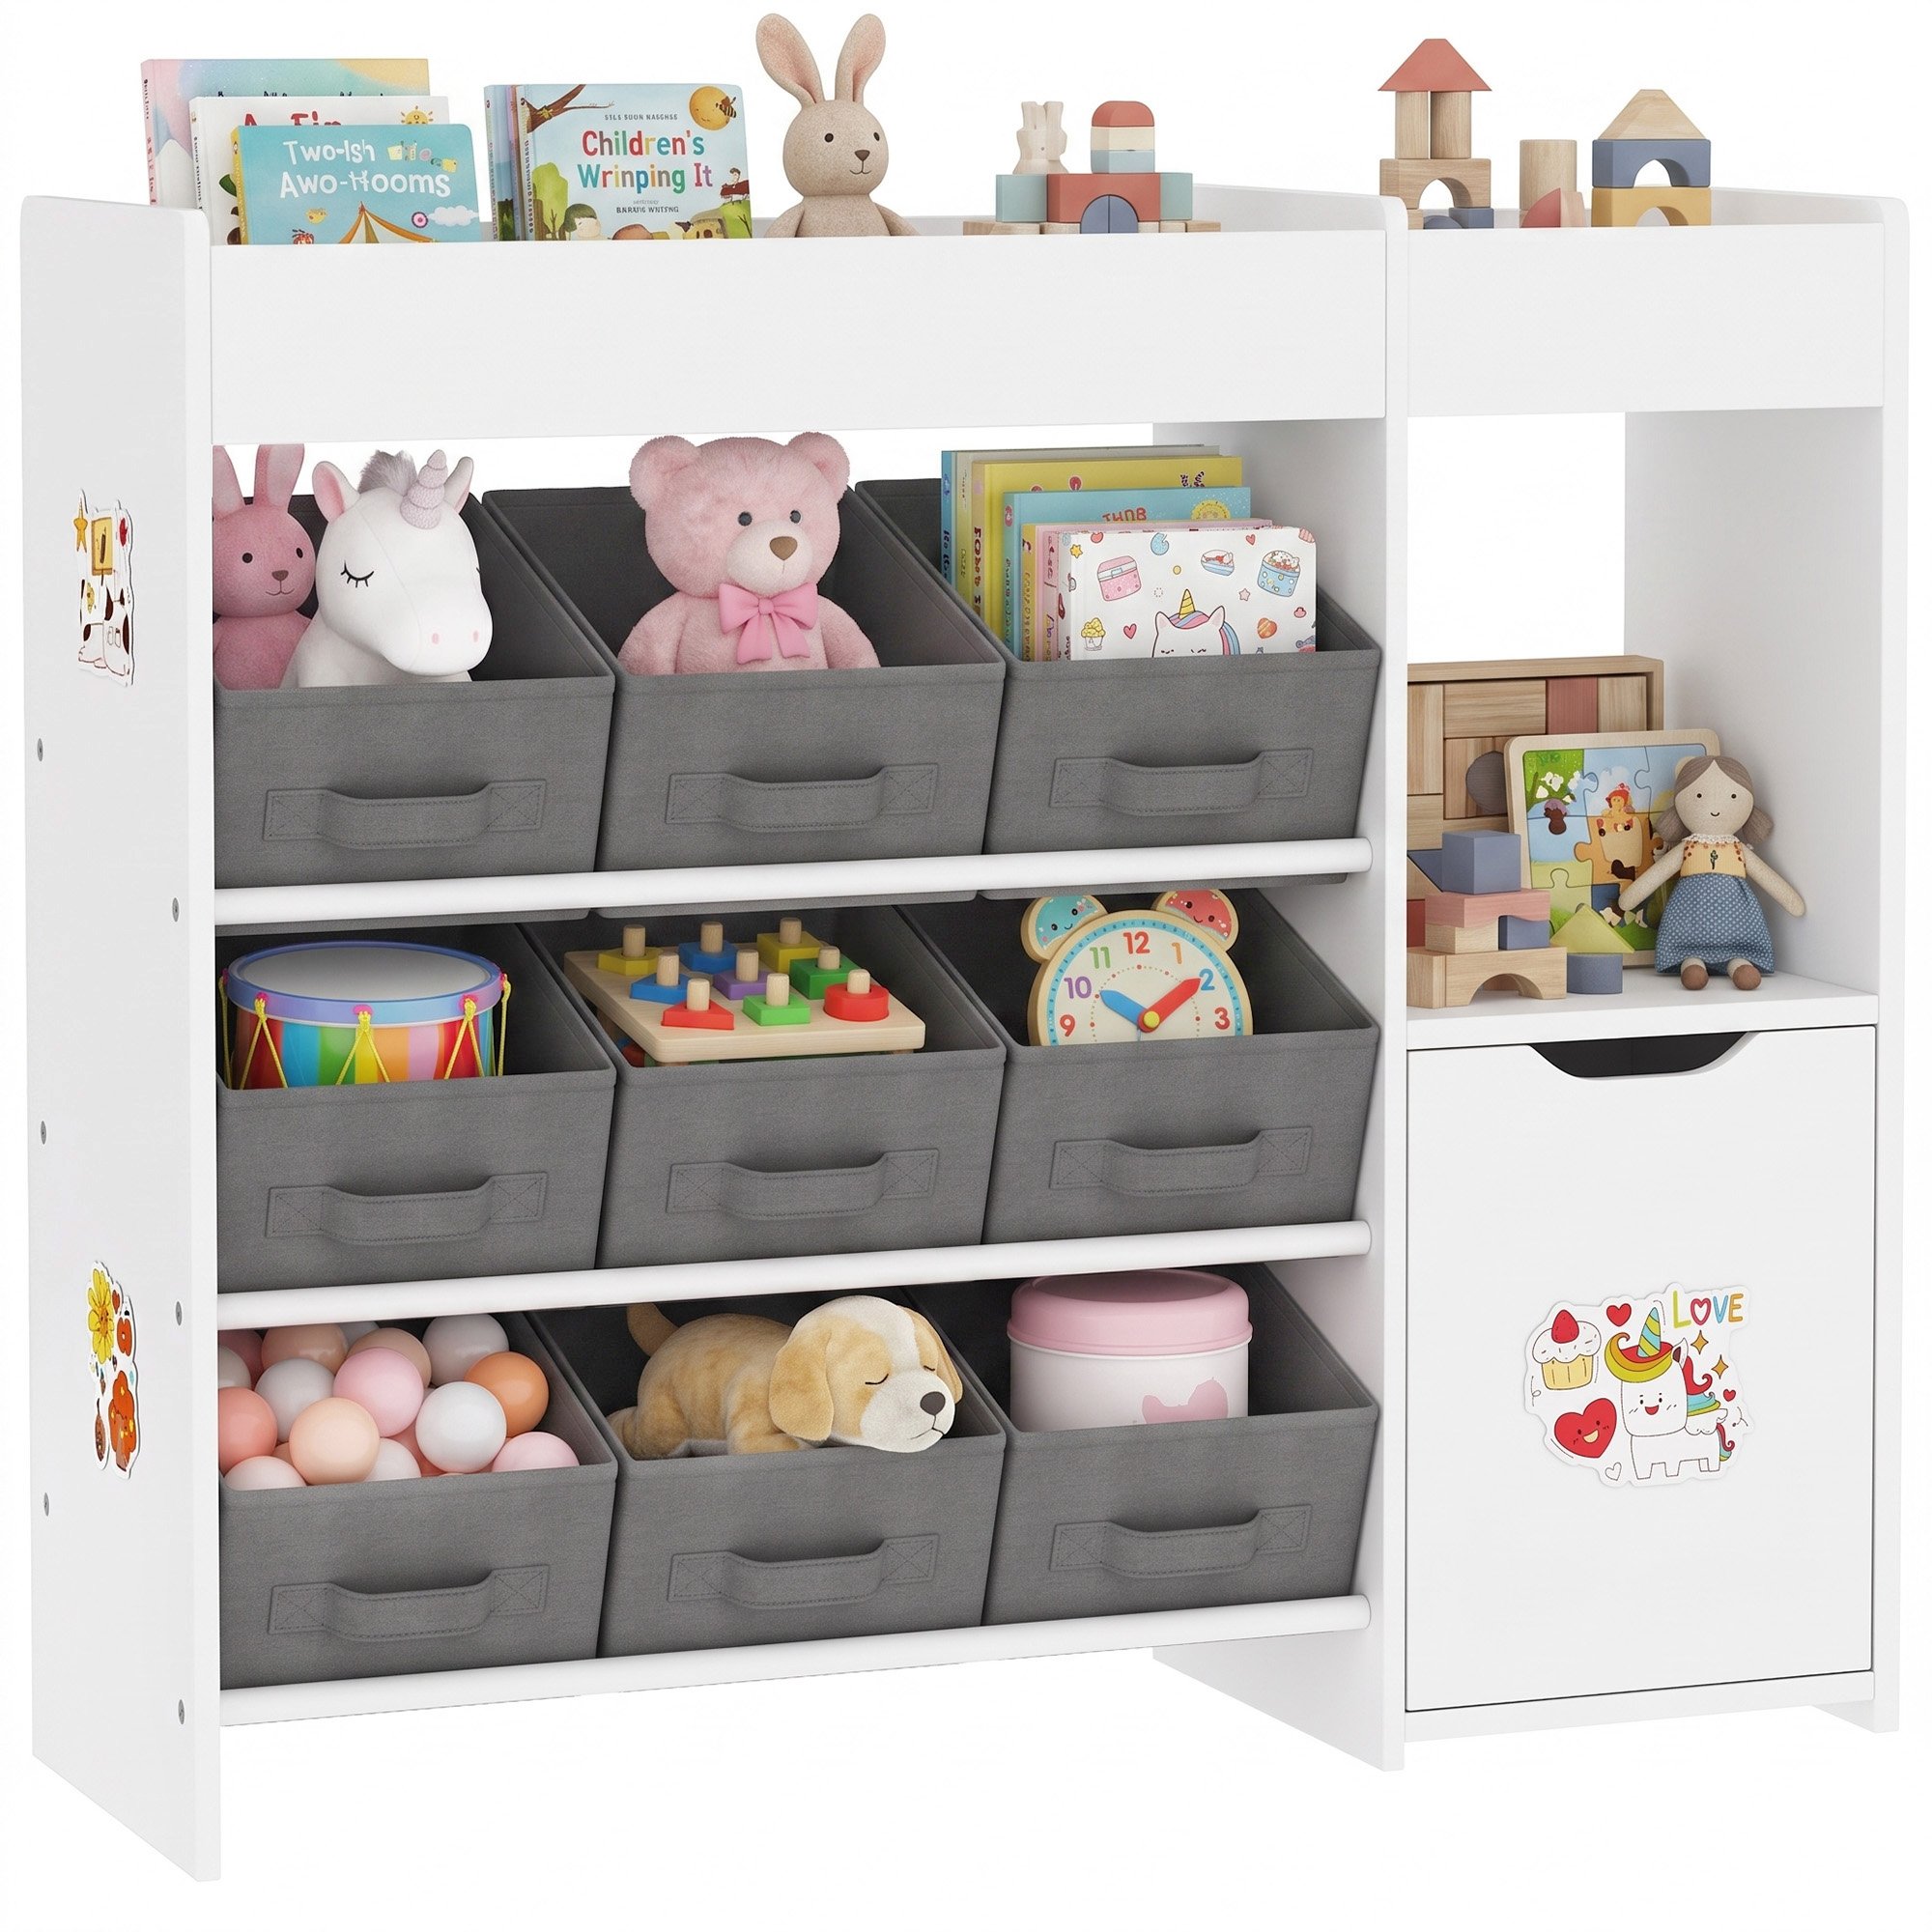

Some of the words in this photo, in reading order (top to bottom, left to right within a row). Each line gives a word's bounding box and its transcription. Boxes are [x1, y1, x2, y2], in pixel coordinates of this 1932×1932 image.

[582, 129, 705, 156] Children's
[577, 163, 686, 194] Wrinping
[694, 162, 714, 187] It
[1123, 931, 1151, 954] 12
[1172, 942, 1182, 964] 1
[1090, 946, 1111, 969] 11
[1064, 976, 1093, 999] 10
[1199, 968, 1215, 991] 2
[1060, 1014, 1076, 1037] 9
[1214, 1008, 1231, 1030] 3
[1672, 1290, 1745, 1328] LOVE
